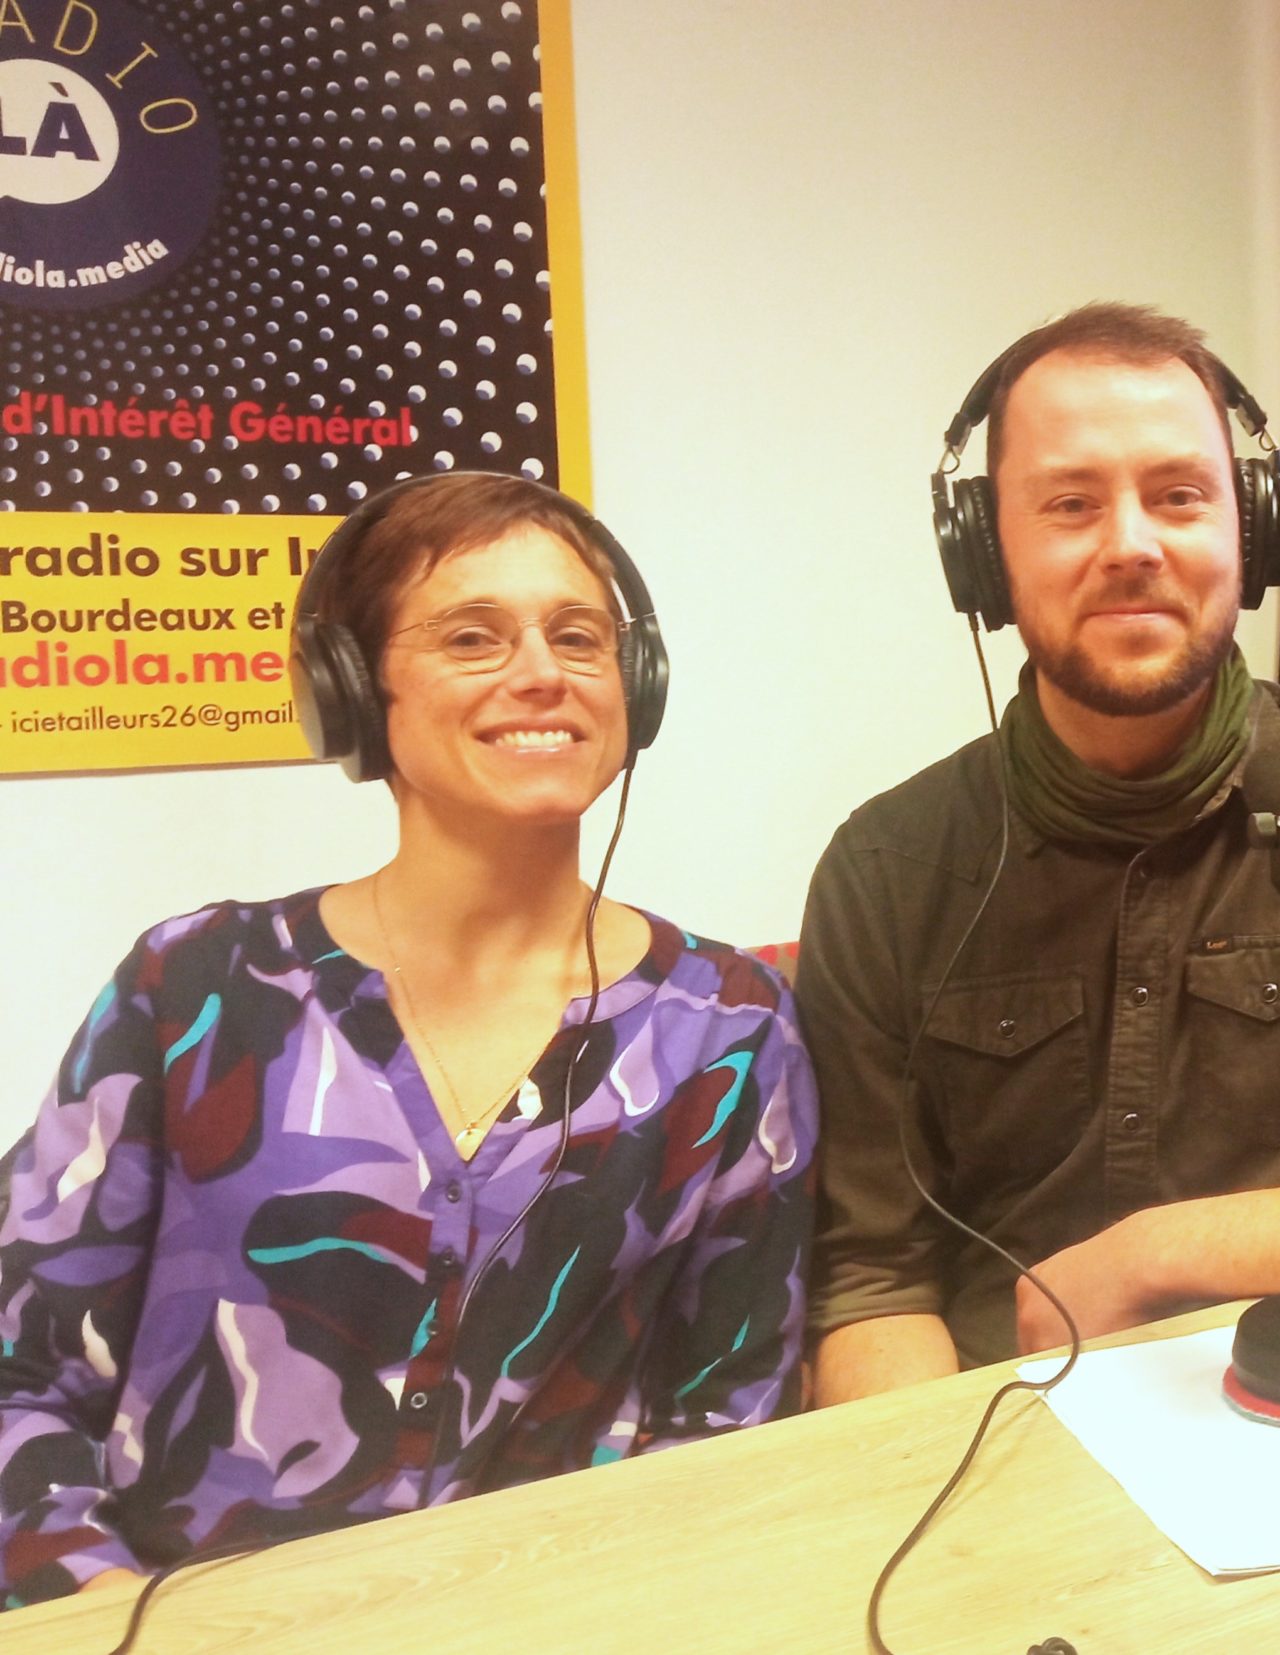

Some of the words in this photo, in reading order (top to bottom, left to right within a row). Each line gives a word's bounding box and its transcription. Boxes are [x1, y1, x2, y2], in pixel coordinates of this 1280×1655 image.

[2, 391, 214, 440] d'Intérêt
[229, 400, 412, 447] Général
[0, 532, 160, 577] radio
[180, 547, 269, 577] sur
[1, 598, 236, 633] Bourdeaux
[248, 602, 285, 630] et
